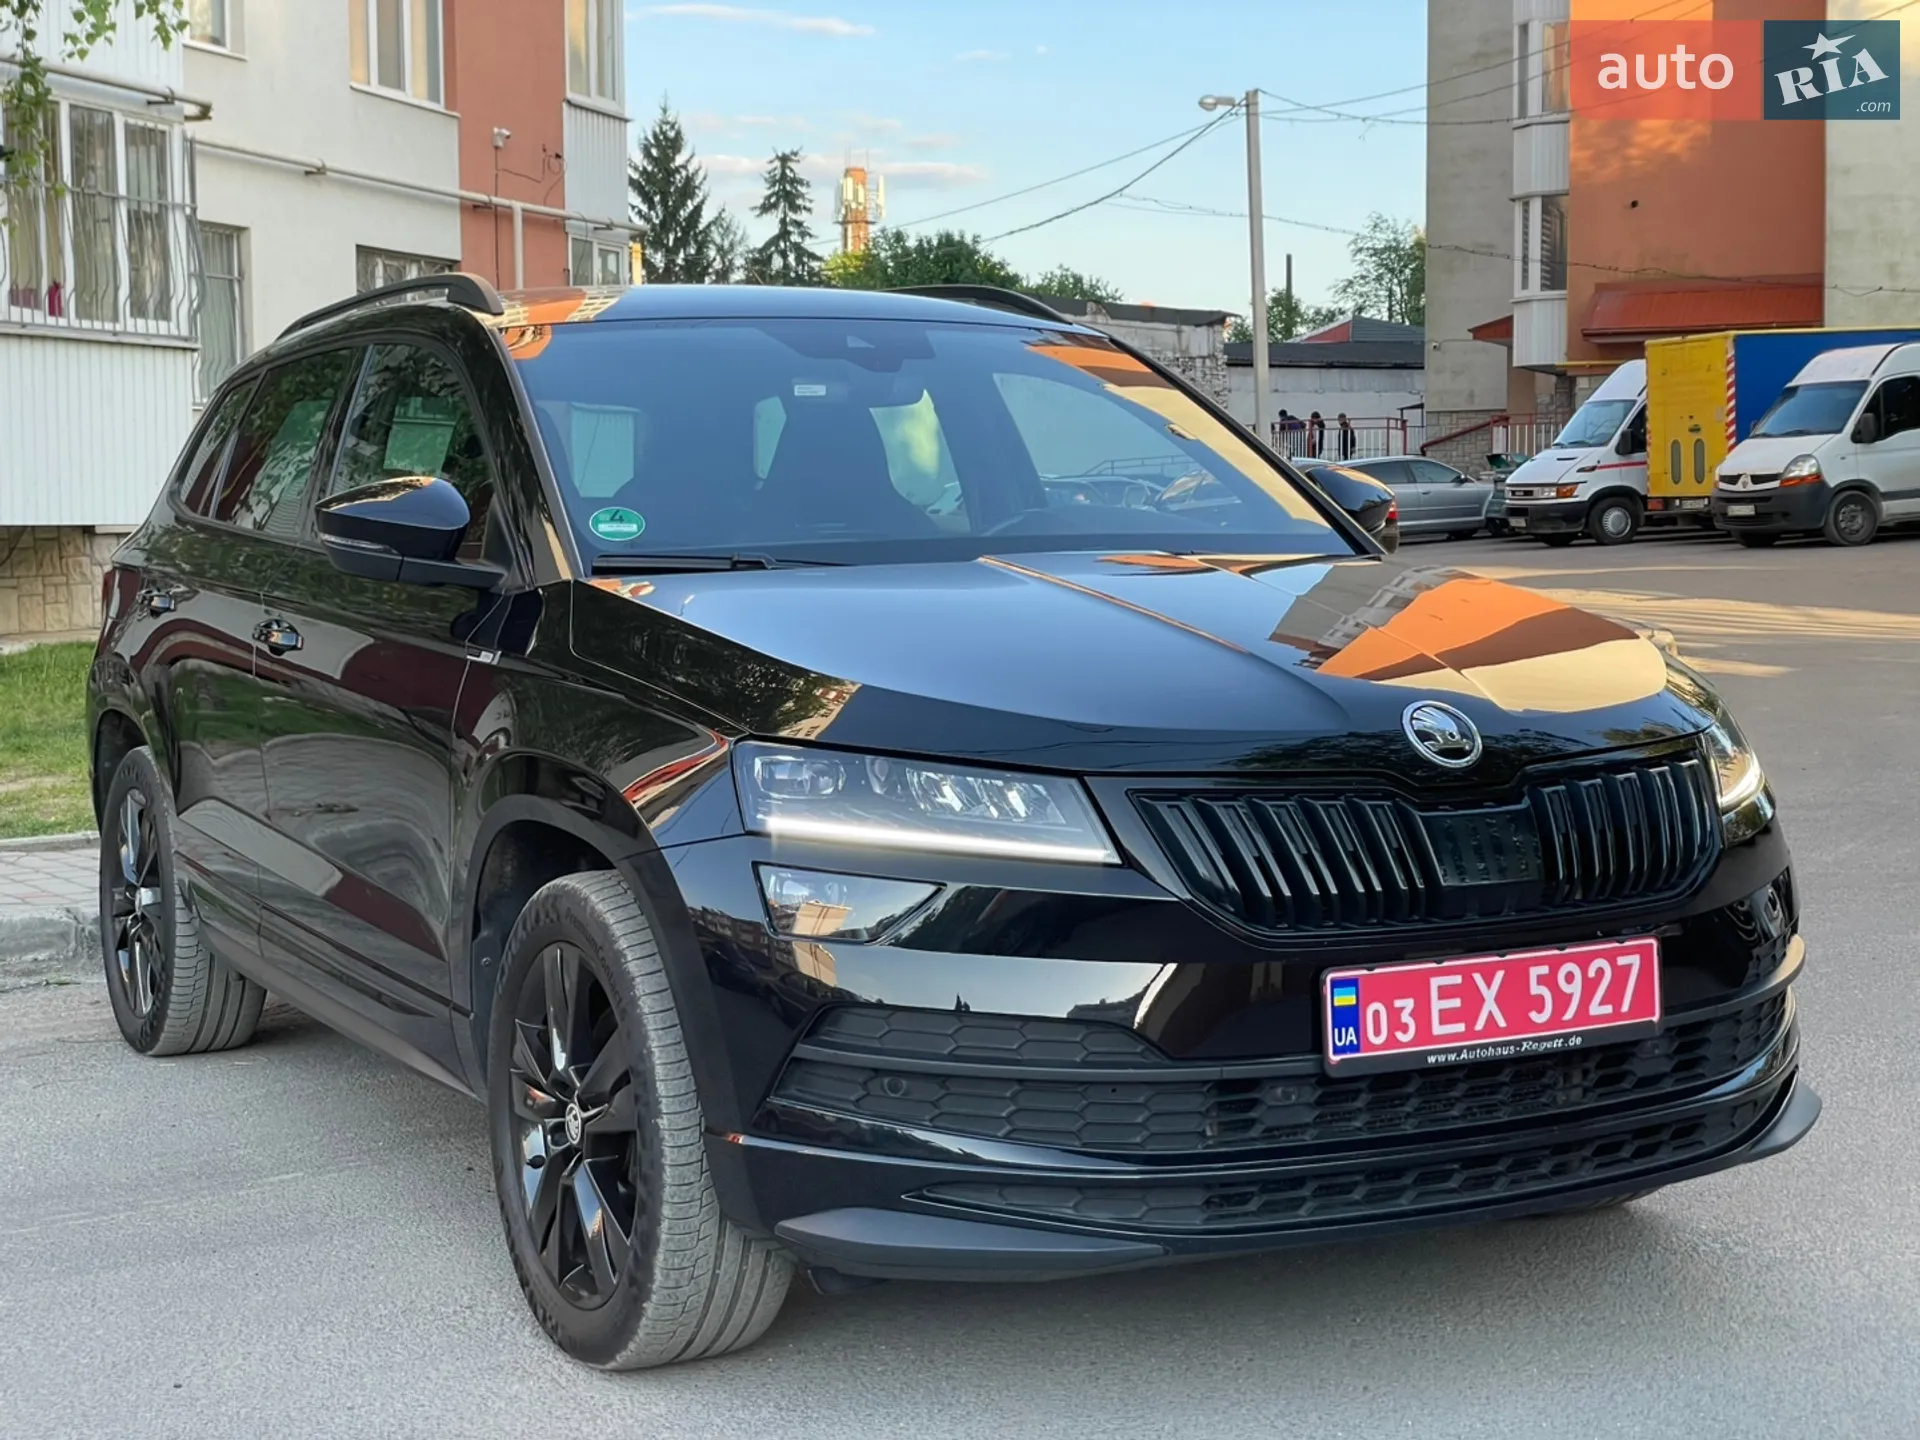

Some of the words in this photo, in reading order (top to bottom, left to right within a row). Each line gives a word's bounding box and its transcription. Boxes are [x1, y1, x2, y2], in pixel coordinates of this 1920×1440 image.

[609, 509, 624, 523] 4
[1366, 998, 1416, 1045] 03
[1430, 970, 1507, 1036] EX
[1528, 954, 1641, 1024] 5927
[1334, 1026, 1357, 1047] UA
